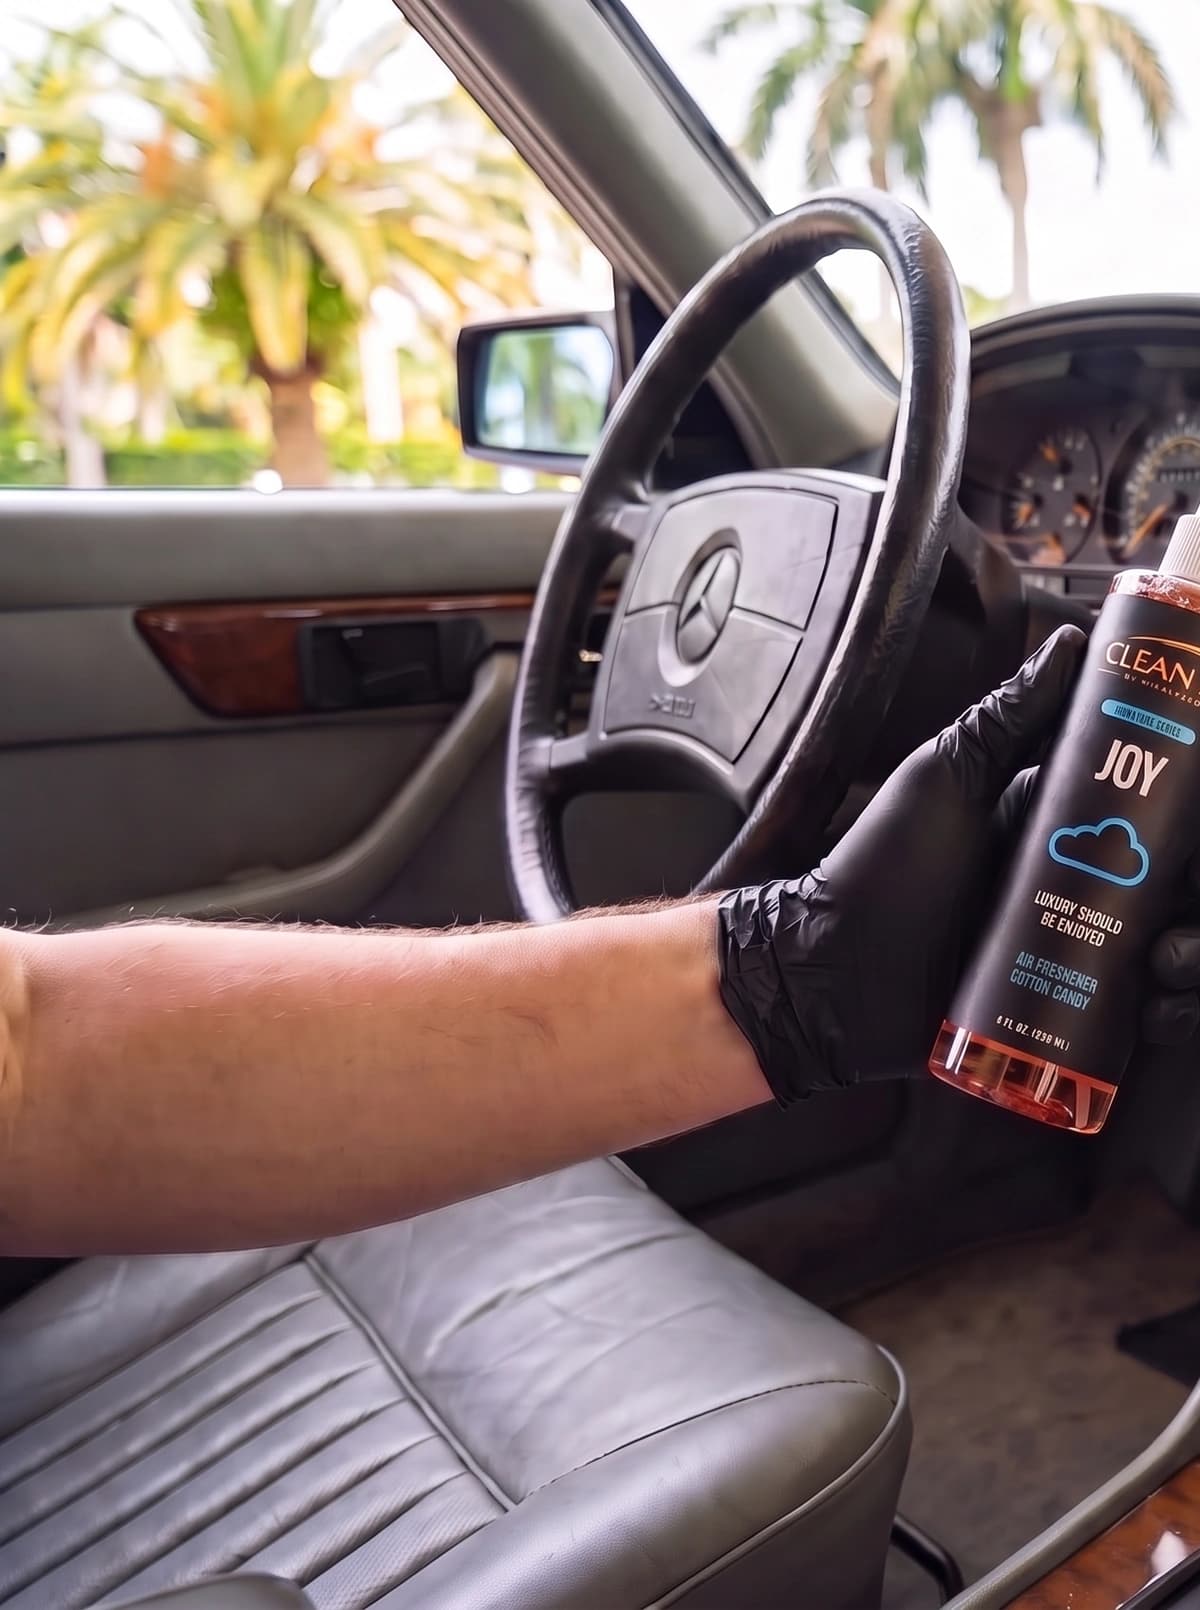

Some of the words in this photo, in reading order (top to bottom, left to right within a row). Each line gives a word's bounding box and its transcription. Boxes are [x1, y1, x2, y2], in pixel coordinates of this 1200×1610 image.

[1106, 642, 1195, 690] CLEAN
[1094, 739, 1169, 798] JOY
[1034, 890, 1078, 916] LUXURY
[1077, 906, 1123, 935] SHOULD
[1040, 911, 1056, 928] BE
[1056, 919, 1106, 947] ENJOYED
[1015, 951, 1035, 970] AIR
[1010, 969, 1051, 996] COTTON
[1052, 985, 1091, 1010] CANDY
